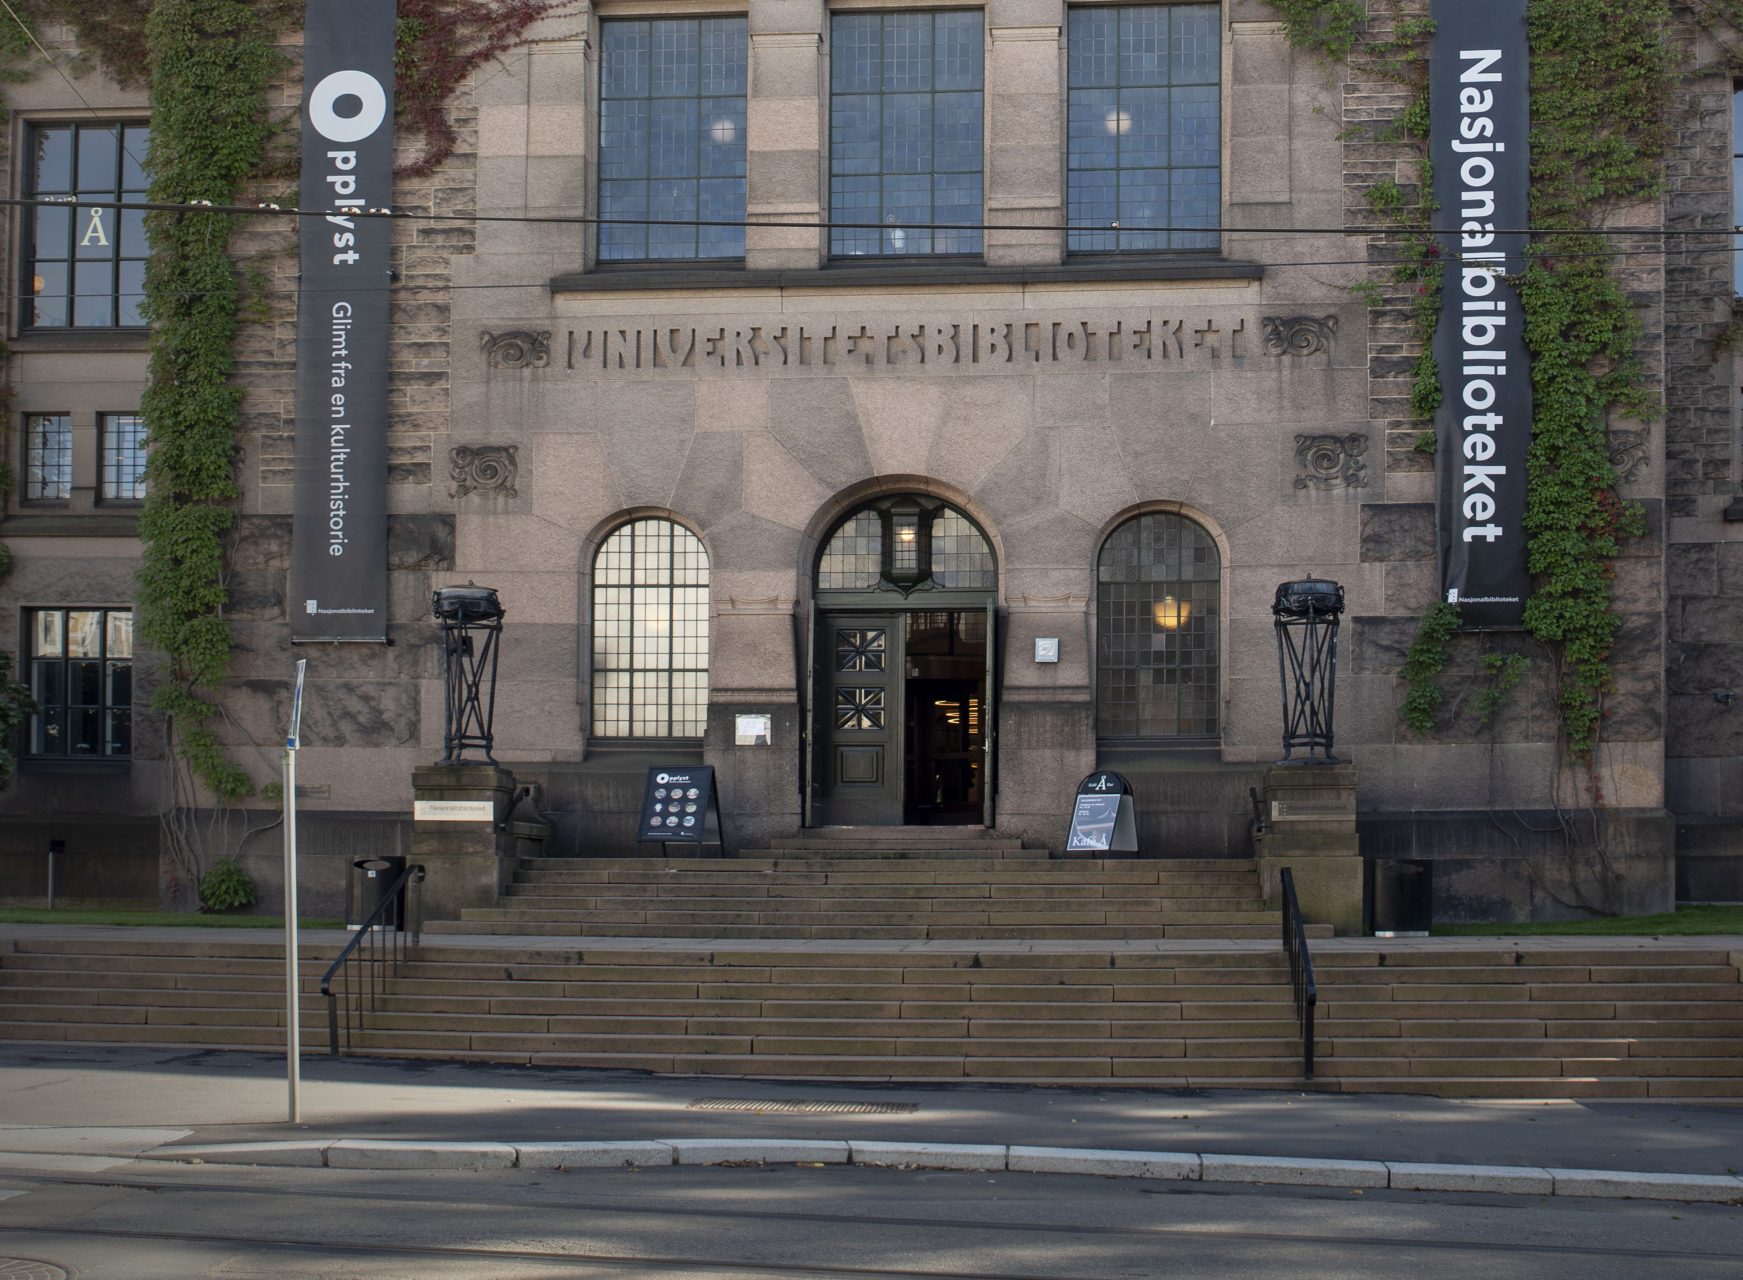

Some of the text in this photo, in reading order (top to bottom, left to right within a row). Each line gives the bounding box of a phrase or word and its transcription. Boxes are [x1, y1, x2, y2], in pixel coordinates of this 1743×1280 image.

[80, 207, 109, 245] Å
[309, 70, 387, 265] Opplyst
[570, 318, 1245, 369] UNIVERSITETSBIBLIOTEKET
[1451, 49, 1506, 543] Nasjonalbiblioteket
[328, 301, 353, 557] Glimt fra en kulturhistorie
[1095, 775, 1107, 790] Å
